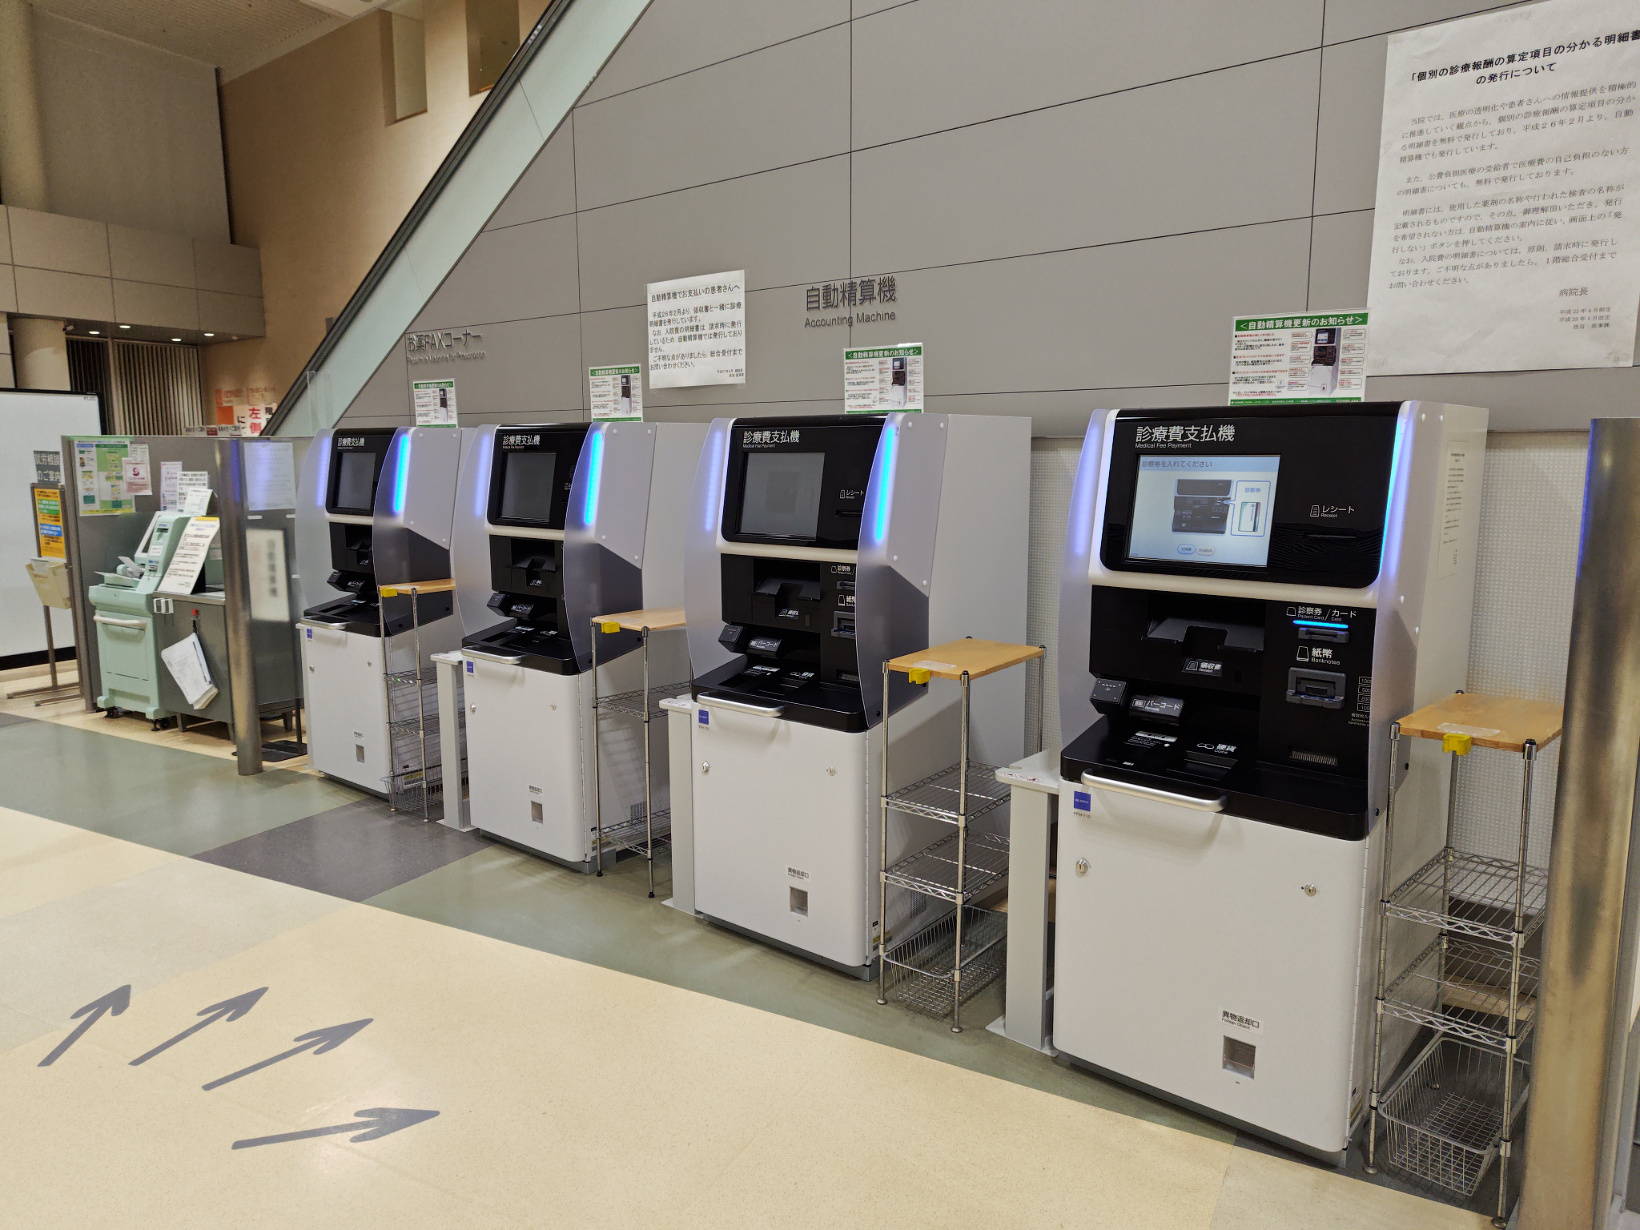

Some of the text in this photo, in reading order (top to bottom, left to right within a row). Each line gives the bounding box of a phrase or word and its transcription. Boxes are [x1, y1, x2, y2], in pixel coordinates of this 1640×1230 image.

[1476, 62, 1557, 84] の発行について
[651, 284, 741, 302] 自動精算機でお支払いの患者さんへ
[806, 276, 897, 312] 自動精算機
[1559, 287, 1589, 297] 病院長
[804, 311, 896, 328] Accounting Machine
[407, 328, 482, 352] お薬FAXコーナー
[743, 430, 800, 443] 診療費支払機
[1135, 424, 1236, 442] 診療費支払機
[1322, 505, 1355, 514] レシート
[1311, 647, 1333, 659] 紙幣
